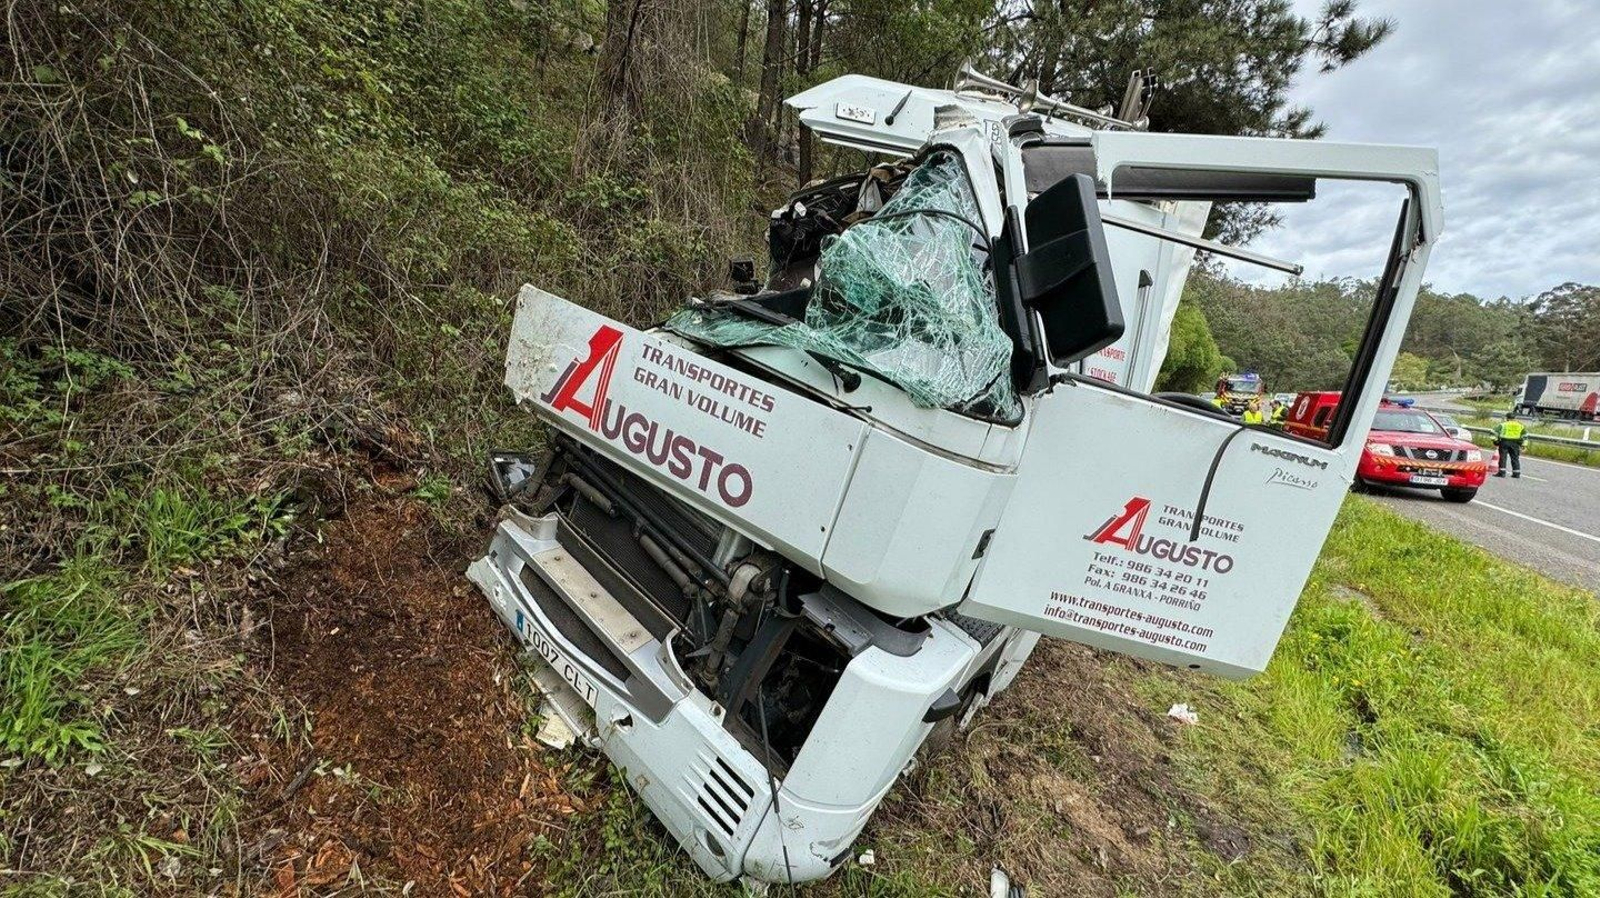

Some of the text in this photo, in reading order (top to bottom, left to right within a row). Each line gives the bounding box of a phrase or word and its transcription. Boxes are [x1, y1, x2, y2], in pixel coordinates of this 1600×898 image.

[641, 342, 776, 413] TRANSPORTES
[541, 324, 753, 508] AUGUSTO
[634, 367, 767, 439] GRAN VOLUME
[1250, 442, 1329, 470] MAGNUM
[1083, 496, 1234, 574] AUGUSTO
[1158, 516, 1240, 543] GRAN OLUME
[1163, 504, 1245, 532] TRANPORTES
[1087, 563, 1208, 600] Fax: 986 34 26 46
[1094, 551, 1209, 588] Telf.: 986 34 20 11
[1050, 591, 1214, 638] www.transportes-augusto.com
[1084, 575, 1101, 588] Pol.
[1103, 580, 1111, 590] A
[1112, 582, 1153, 601] GRANXA
[1160, 594, 1201, 612] PORRIÑO
[1043, 604, 1208, 653] info@transportes-augusto.com
[526, 623, 595, 701] 1007 CLT
